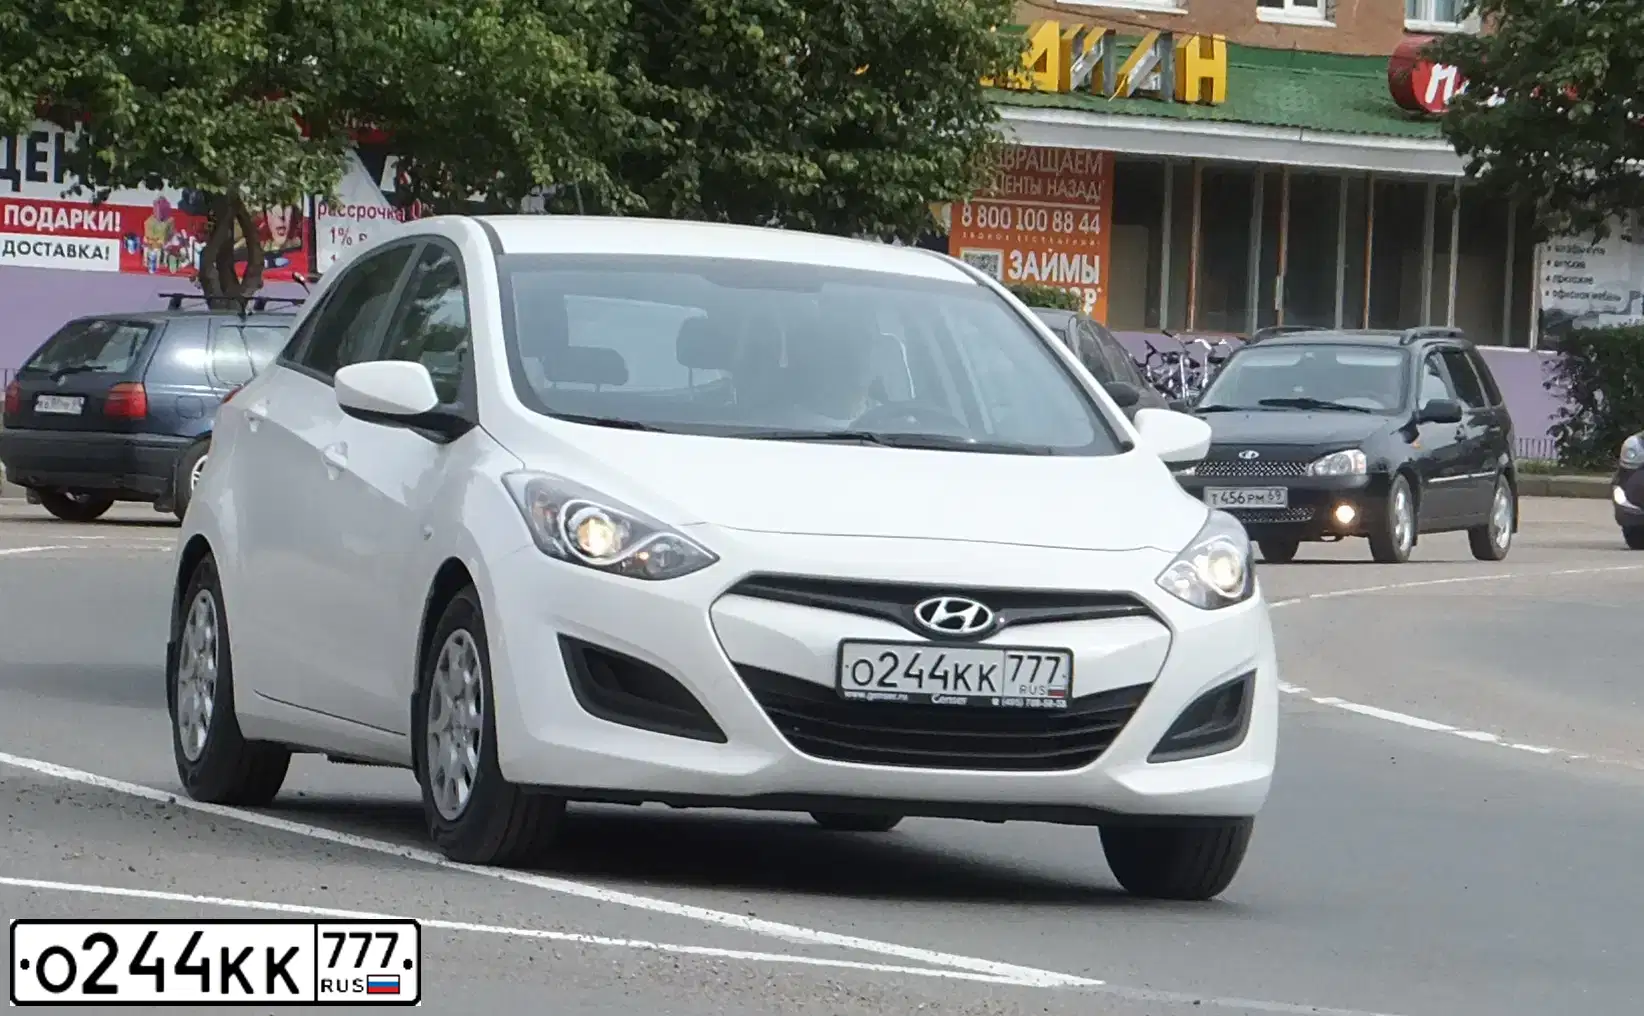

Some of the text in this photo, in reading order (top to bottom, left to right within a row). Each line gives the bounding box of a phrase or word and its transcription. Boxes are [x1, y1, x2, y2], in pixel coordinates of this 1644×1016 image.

[980, 20, 1226, 104] ДИАН
[4, 204, 121, 233] ПОДАРКИ!
[961, 202, 1101, 235] 8 800 100 88 44
[2, 239, 110, 261] ДОСТАВКА!
[330, 226, 353, 247] 1%
[1007, 248, 1100, 285] ЗАЙМЫ
[851, 651, 1062, 693] О244КК 777
[1019, 685, 1047, 696] RUS
